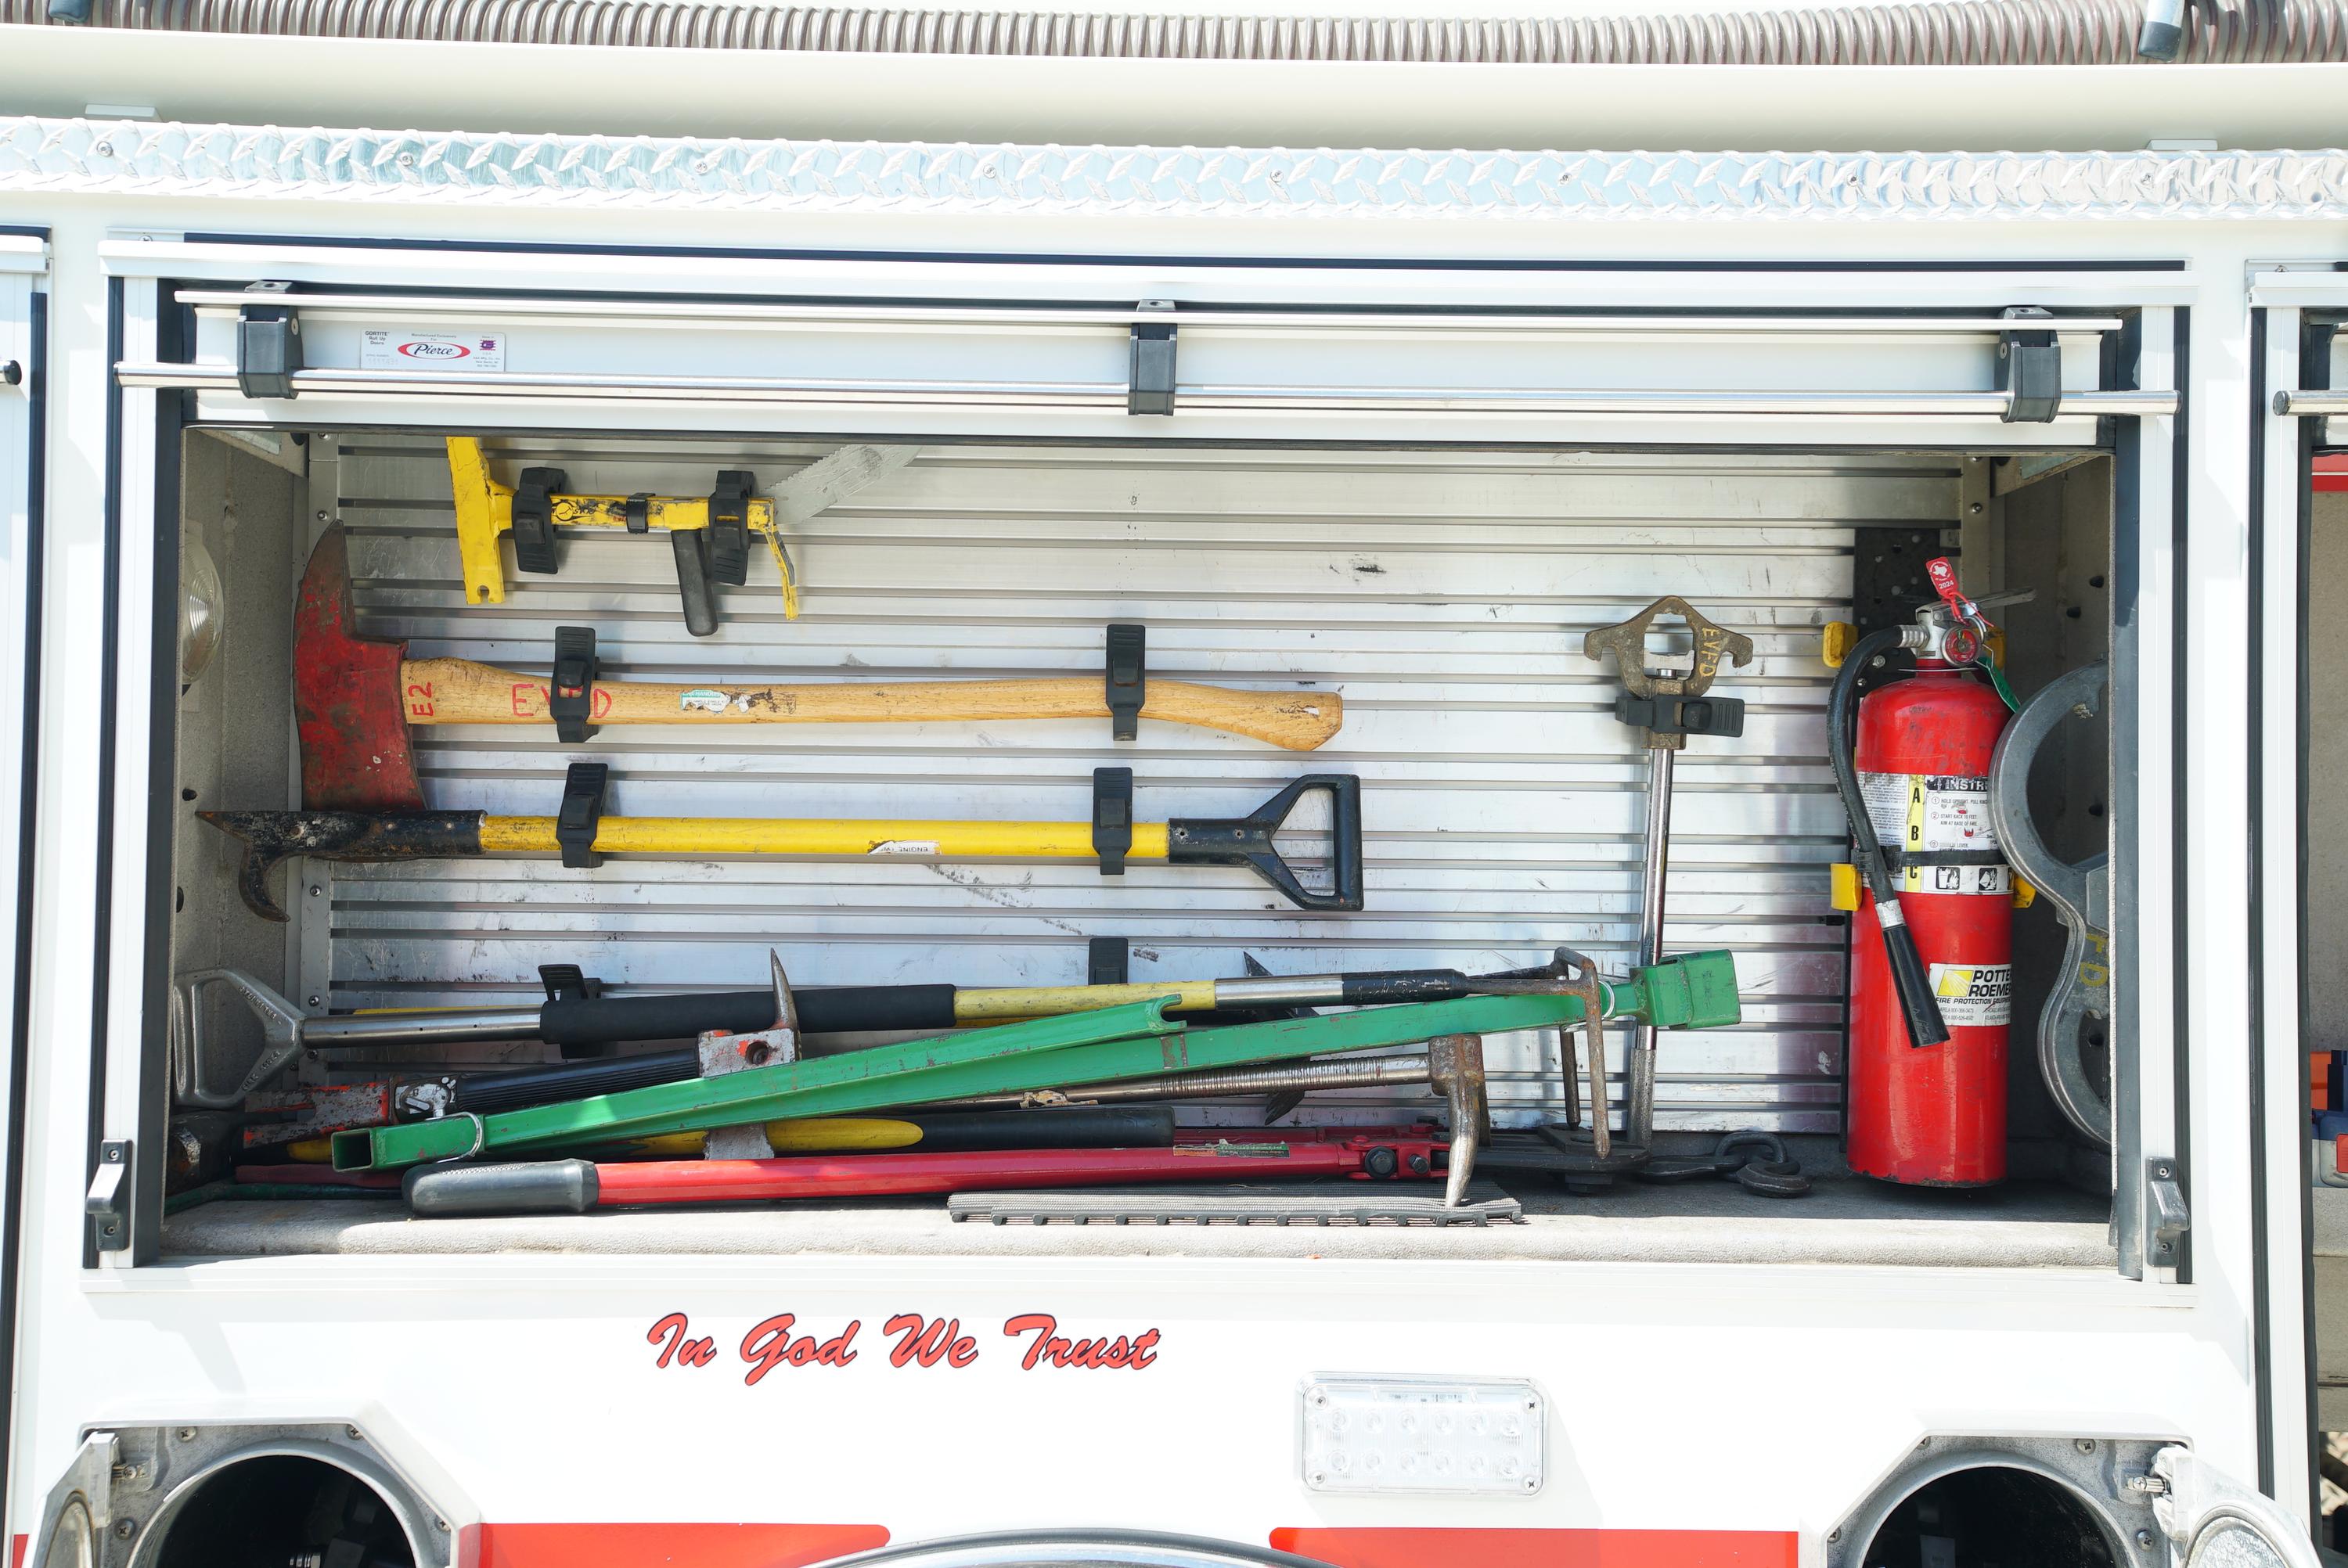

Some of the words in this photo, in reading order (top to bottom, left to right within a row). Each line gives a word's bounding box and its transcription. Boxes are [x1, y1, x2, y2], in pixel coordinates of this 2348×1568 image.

[413, 343, 453, 356] Pierce
[1939, 580, 1954, 589] 2024
[408, 682, 433, 717] E2
[1945, 777, 1988, 790] INSTR
[1912, 787, 1921, 804] A
[1911, 825, 1919, 841] B
[1909, 865, 1918, 879] C
[1972, 969, 2011, 983] POTTE
[1968, 983, 2011, 997] ROEME
[646, 1311, 717, 1369] In
[740, 1312, 861, 1386] God
[882, 1312, 978, 1368] We
[1003, 1313, 1161, 1370] Trust
